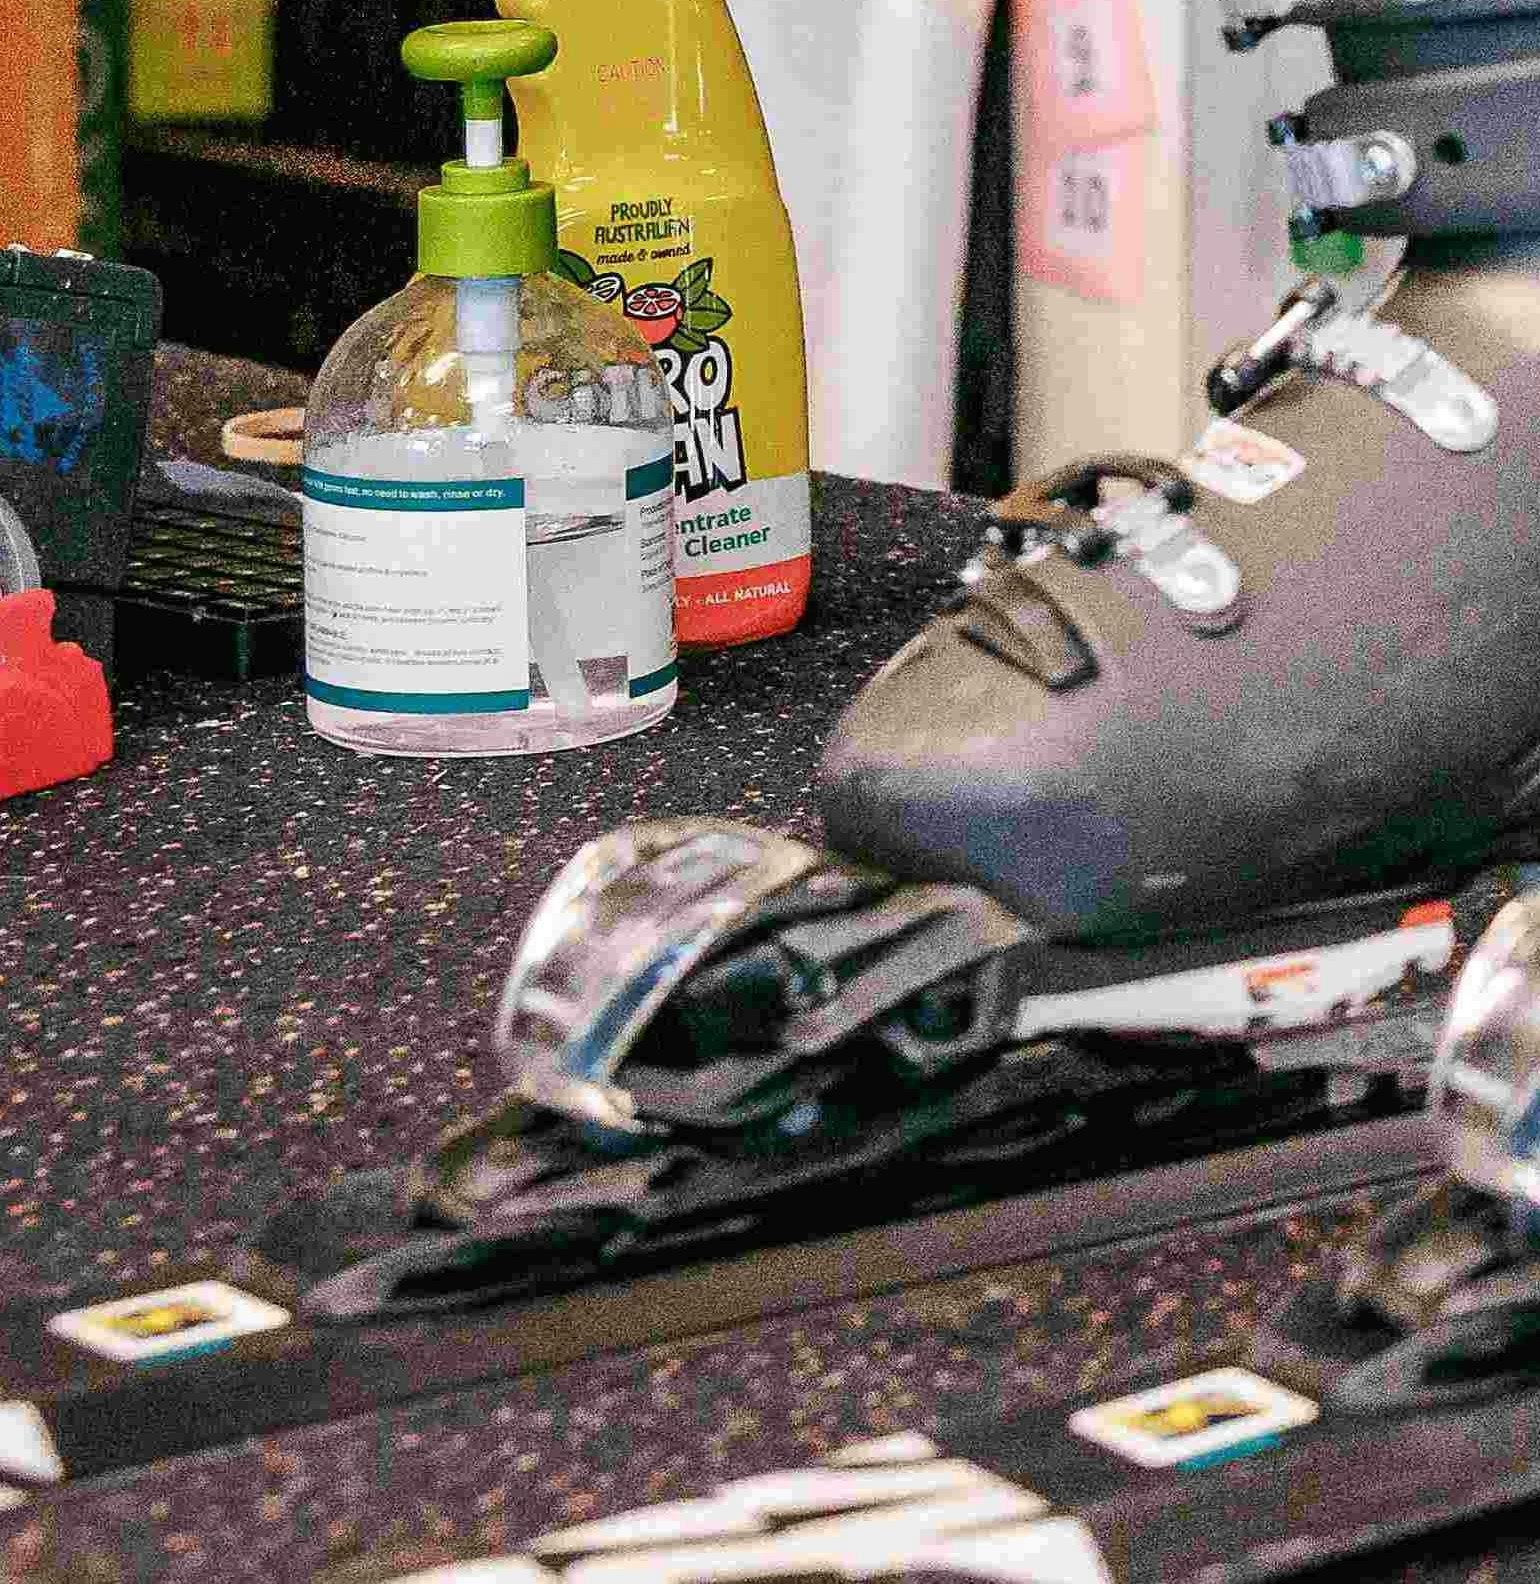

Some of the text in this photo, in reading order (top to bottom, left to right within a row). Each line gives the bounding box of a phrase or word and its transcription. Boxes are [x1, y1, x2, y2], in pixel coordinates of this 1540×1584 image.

[610, 197, 675, 223] PROUDLY
[594, 217, 691, 245] AUSTRALIAN
[596, 250, 635, 266] made
[649, 244, 692, 261] owned
[410, 489, 442, 500] wash,
[442, 489, 470, 500] rinse
[471, 490, 484, 499] or
[485, 488, 507, 500] dry.
[674, 505, 753, 536] ntrate
[684, 524, 771, 558] Cleaner
[704, 589, 731, 605] ALL
[733, 579, 792, 602] NATURAL
